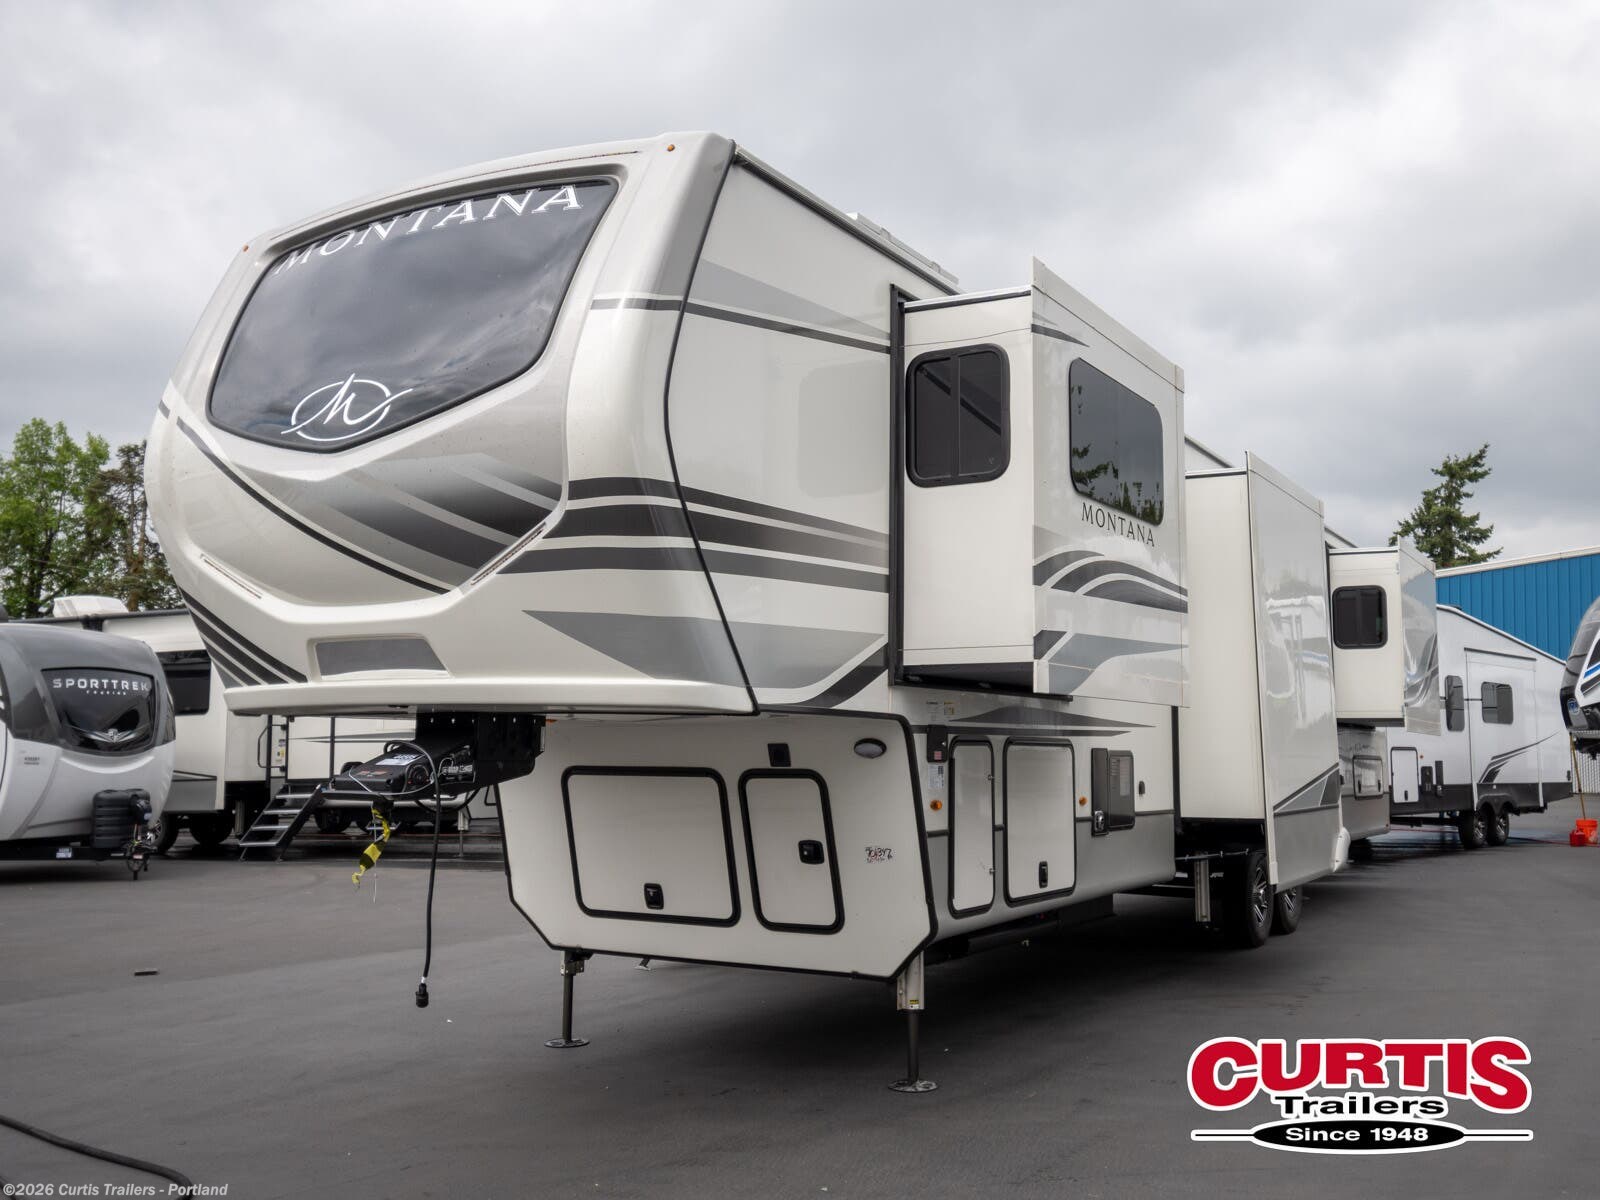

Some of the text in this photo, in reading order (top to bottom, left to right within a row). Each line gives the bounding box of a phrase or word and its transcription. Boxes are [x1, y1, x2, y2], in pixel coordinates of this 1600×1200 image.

[270, 185, 583, 277] MONTANA
[1081, 502, 1155, 547] MONTANA
[52, 678, 149, 692] SPORTTREK
